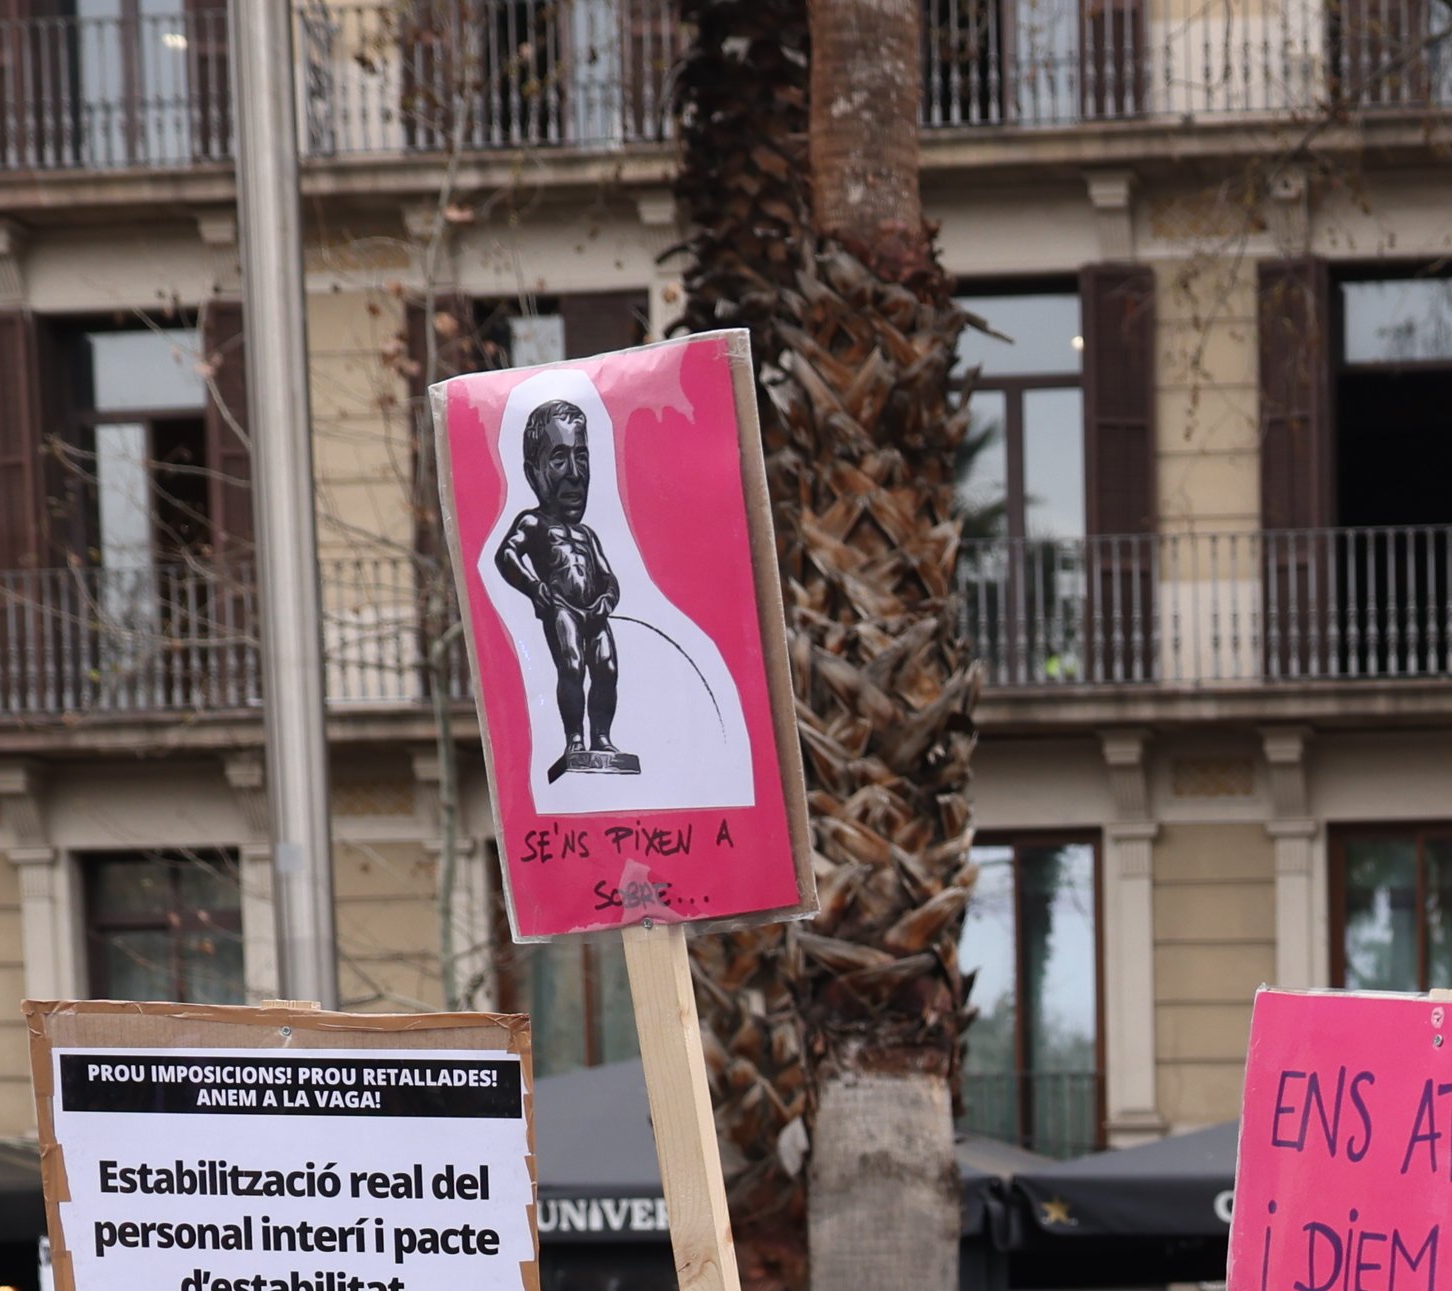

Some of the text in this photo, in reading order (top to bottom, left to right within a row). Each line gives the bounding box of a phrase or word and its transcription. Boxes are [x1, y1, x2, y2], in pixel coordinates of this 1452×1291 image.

[520, 822, 590, 863] SE'NS
[716, 818, 734, 848] A
[88, 1064, 498, 1088] PROU IMPOSICIONS! PROU RETALLADES!
[196, 1088, 381, 1109] ANEM A LA VAGA!
[1271, 1066, 1375, 1163] ENS
[99, 1160, 490, 1201] Estabilització real del
[94, 1215, 500, 1263] personal interí i pacte
